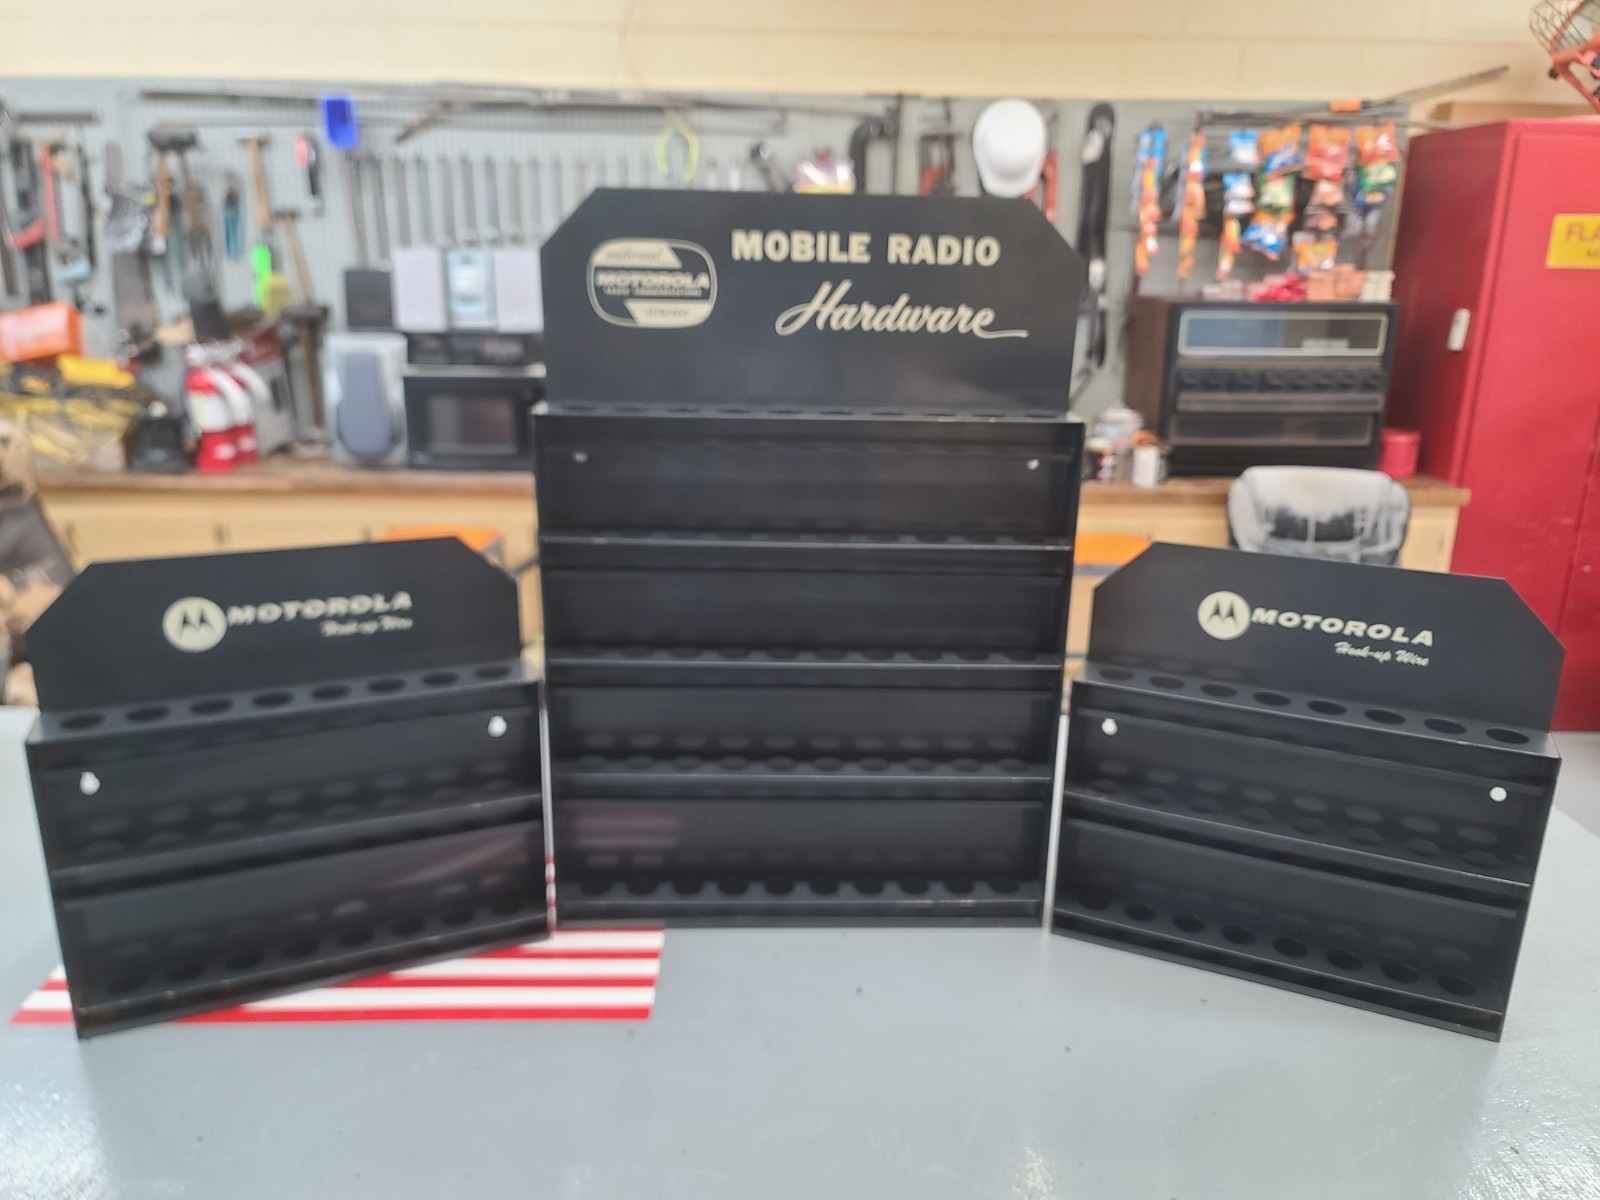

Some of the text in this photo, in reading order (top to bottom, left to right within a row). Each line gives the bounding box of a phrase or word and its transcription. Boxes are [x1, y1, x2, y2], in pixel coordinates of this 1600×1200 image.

[731, 229, 1001, 267] MOBILE RADIO
[595, 270, 711, 290] MOTOROLA
[774, 279, 1028, 339] Hardware
[227, 591, 413, 627] MOTOROLA
[1251, 607, 1434, 647] MOTOROLA
[1395, 649, 1430, 668] Wire
